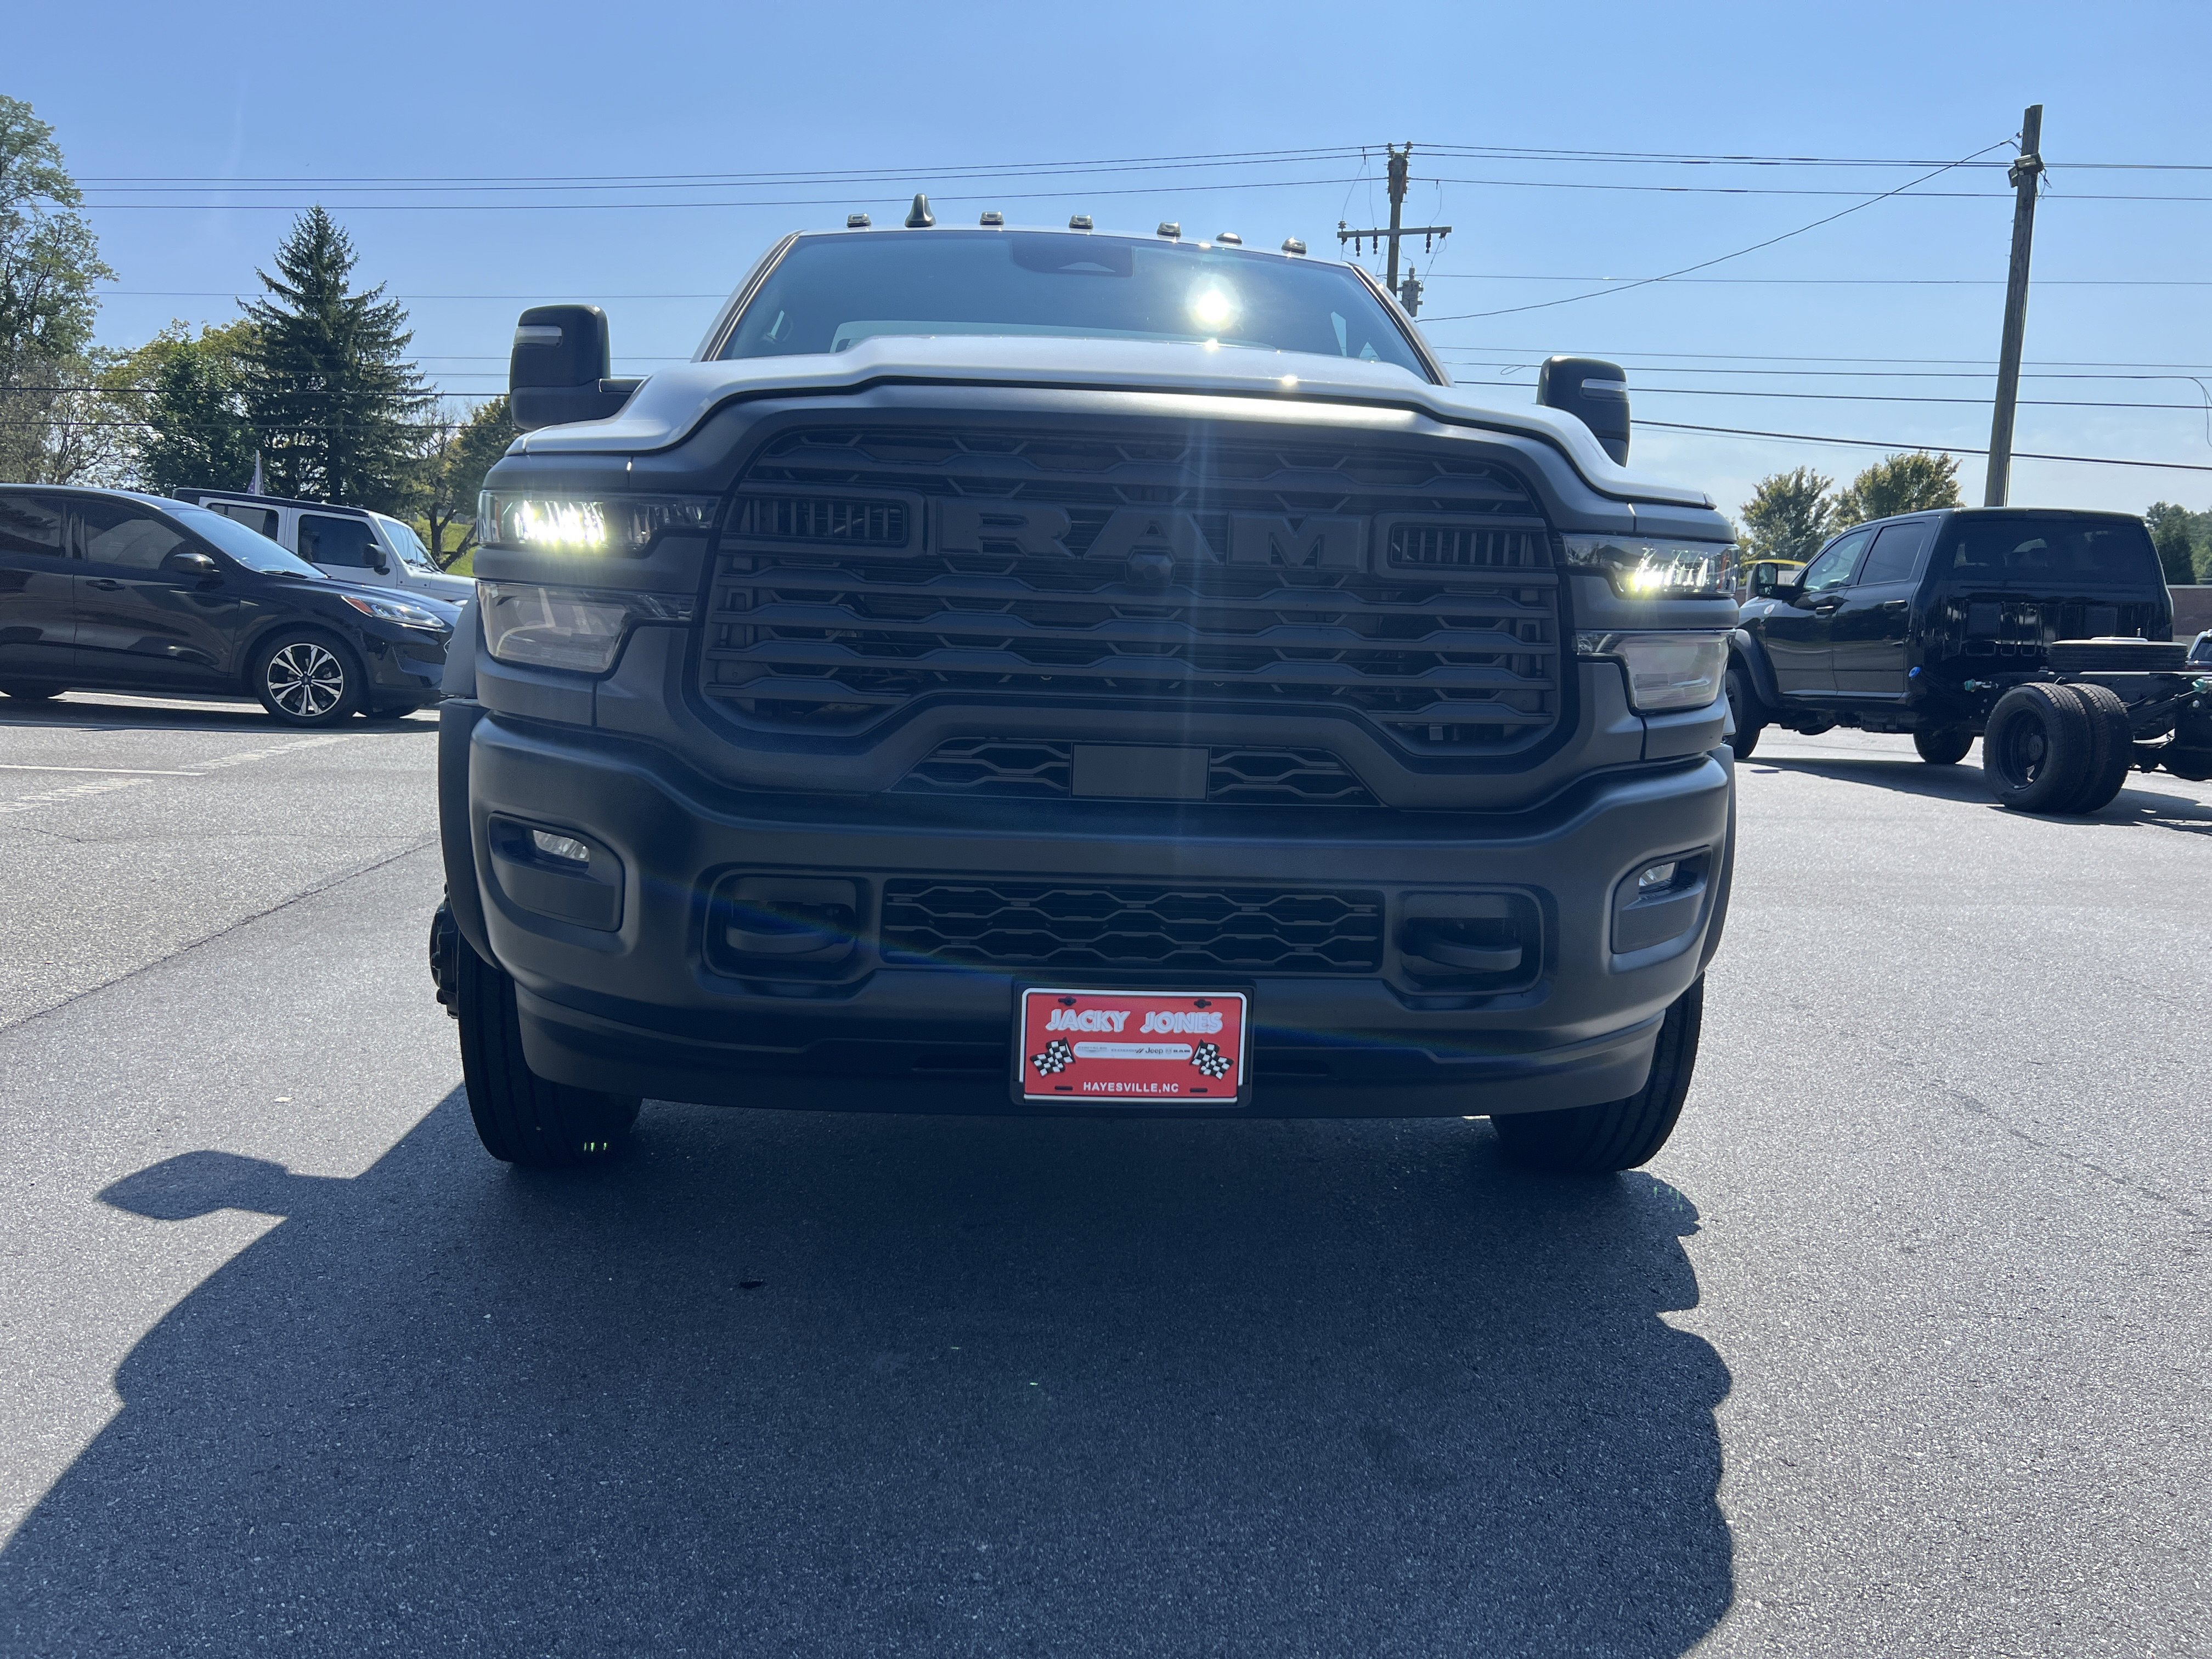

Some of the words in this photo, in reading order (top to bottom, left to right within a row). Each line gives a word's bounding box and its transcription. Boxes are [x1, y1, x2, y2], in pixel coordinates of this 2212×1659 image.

[935, 496, 1363, 572] RAM
[1045, 1008, 1131, 1032] JACKY
[1139, 1011, 1223, 1034] JONES
[1145, 1046, 1164, 1054] Jeep
[1082, 1081, 1180, 1094] HAYESVILLE,NC
